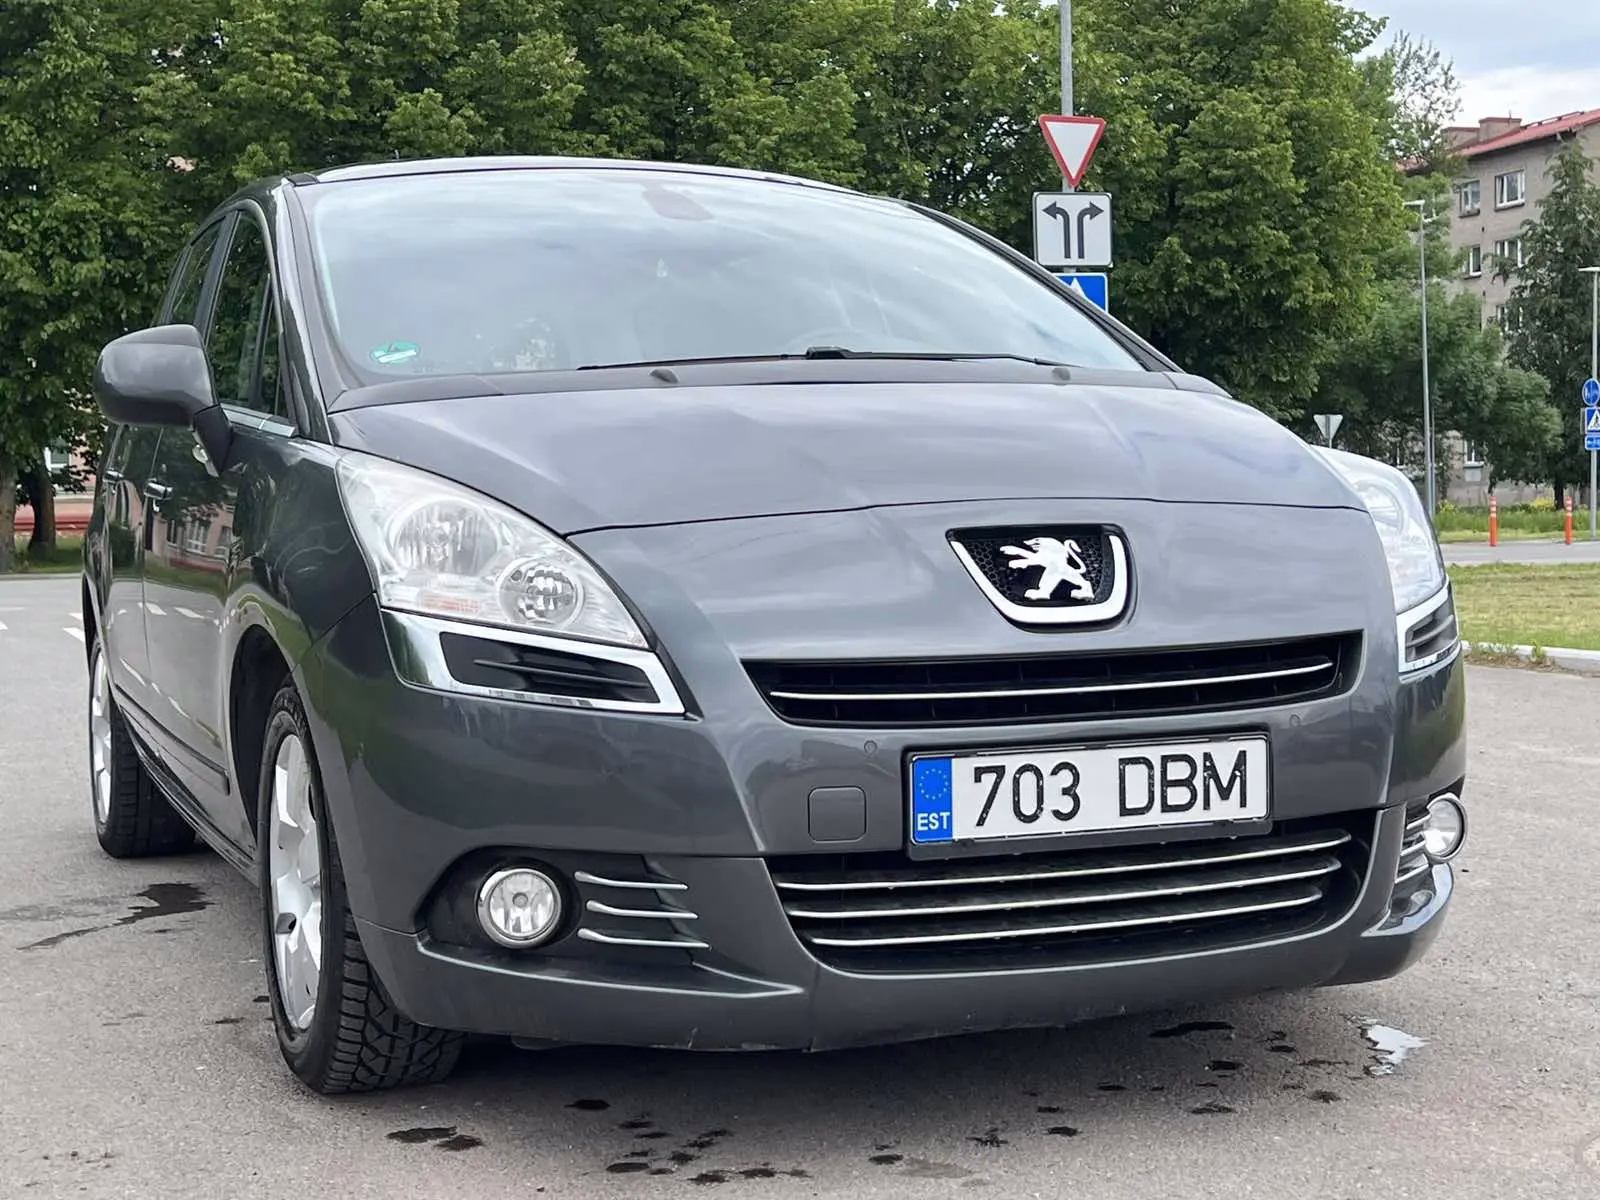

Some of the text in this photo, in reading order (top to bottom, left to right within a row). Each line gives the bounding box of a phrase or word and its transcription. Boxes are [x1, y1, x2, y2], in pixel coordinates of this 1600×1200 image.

[973, 750, 1247, 827] 703 DBM
[916, 811, 951, 832] EST
